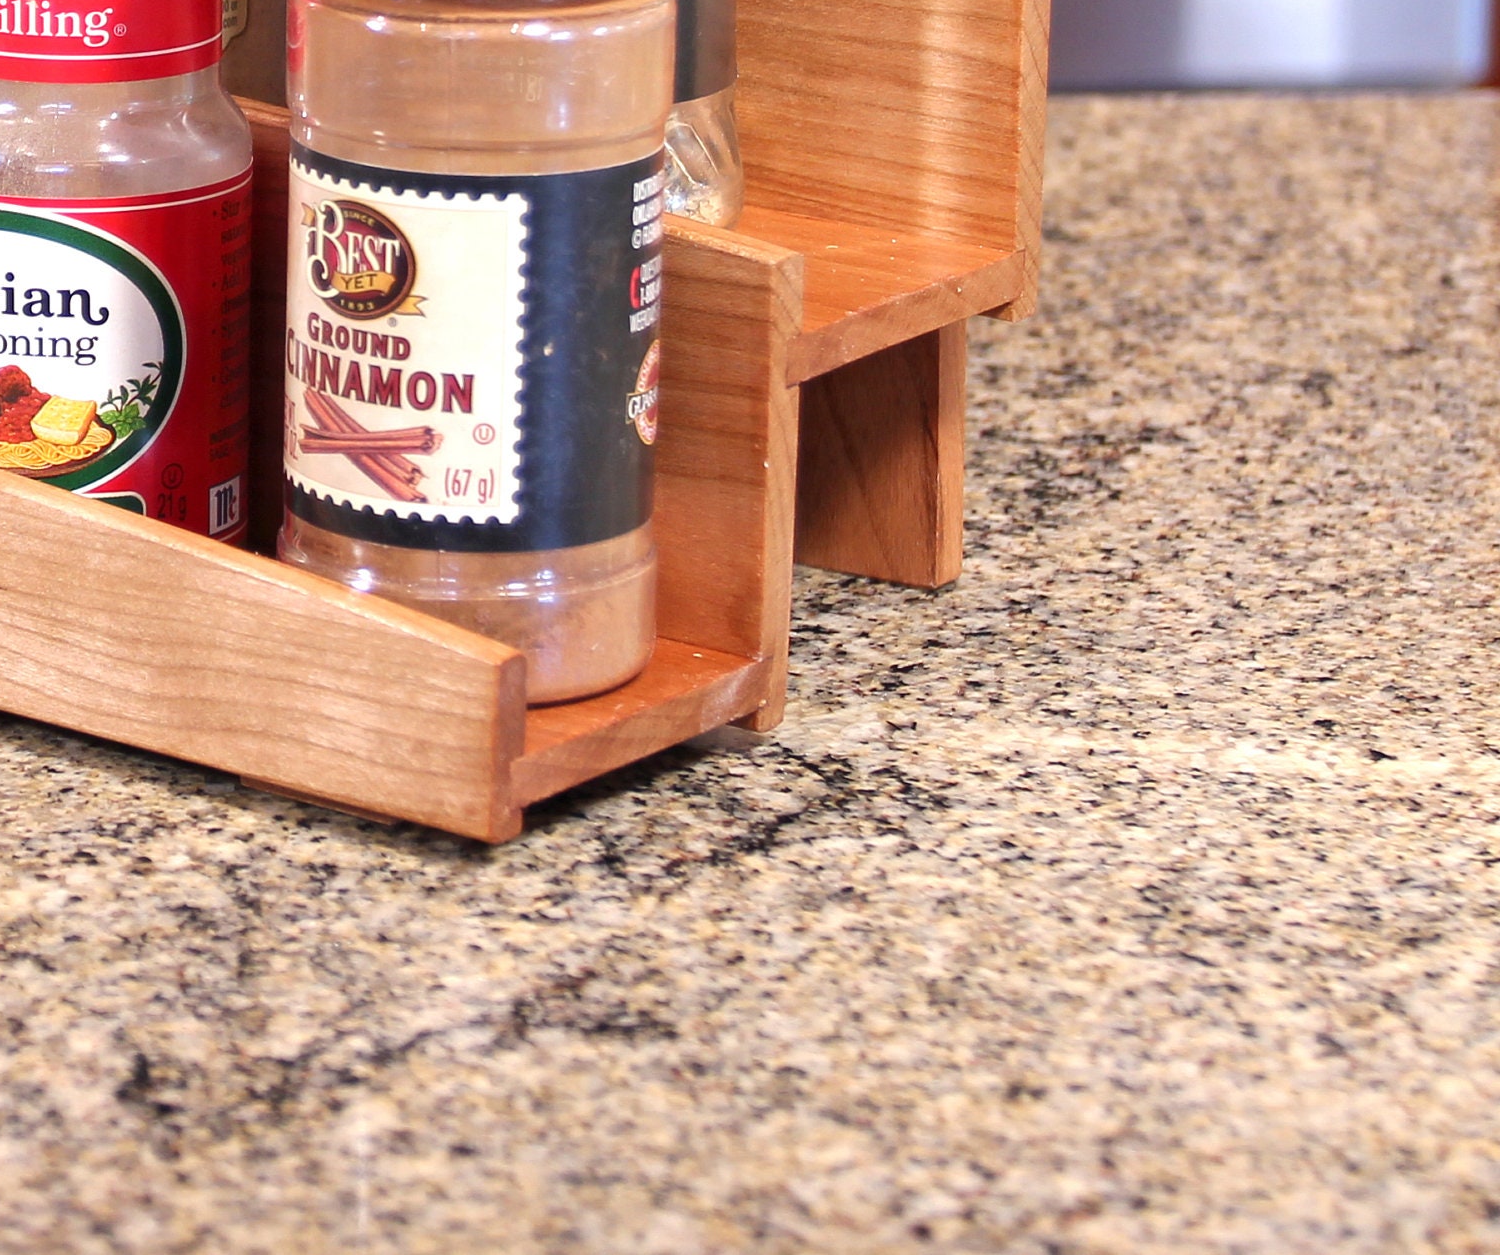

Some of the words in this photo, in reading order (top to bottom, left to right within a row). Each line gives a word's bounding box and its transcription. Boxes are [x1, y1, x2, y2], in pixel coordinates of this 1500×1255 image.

[343, 209, 377, 227] SINCE
[306, 200, 401, 299] BEST
[340, 273, 379, 291] YET
[306, 311, 412, 361] GROUND
[285, 327, 475, 415] CINNAMON
[443, 466, 472, 498] (67
[477, 466, 496, 505] g)
[157, 493, 174, 519] 21
